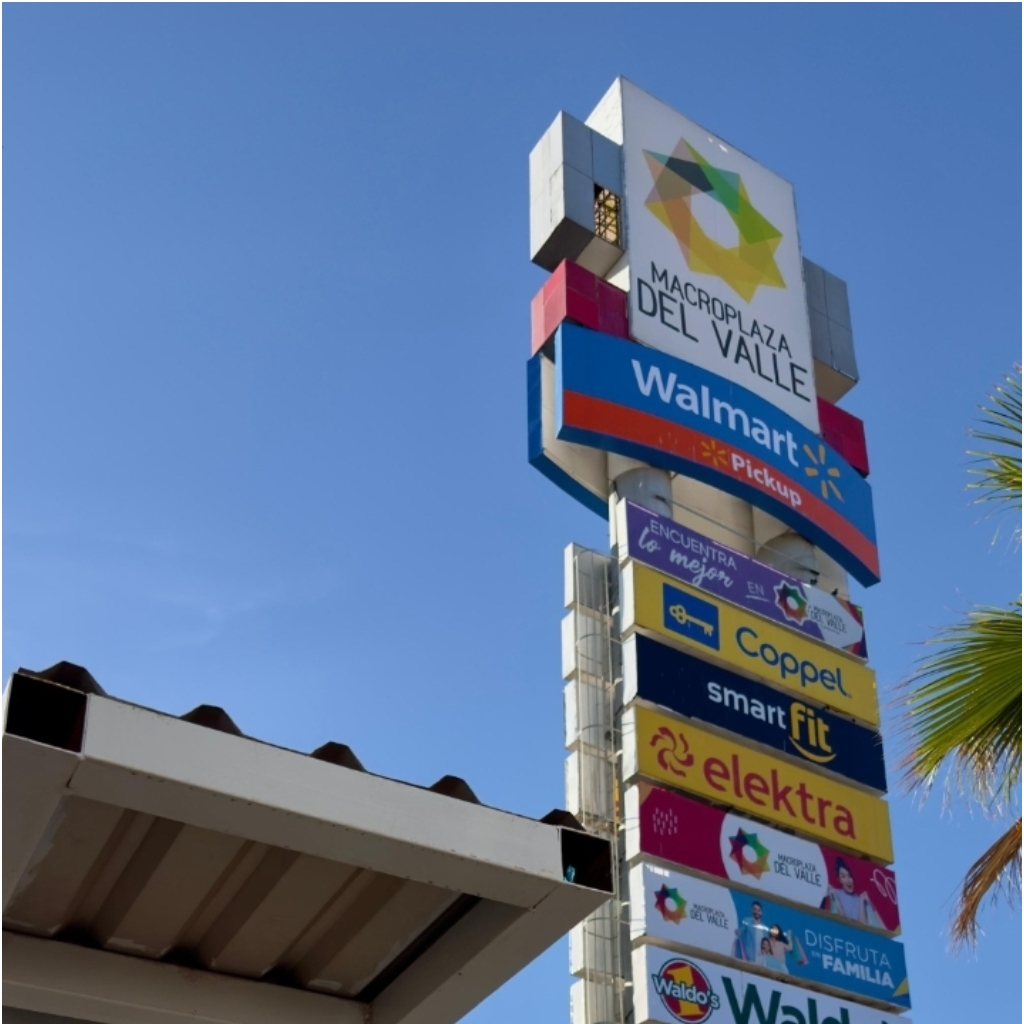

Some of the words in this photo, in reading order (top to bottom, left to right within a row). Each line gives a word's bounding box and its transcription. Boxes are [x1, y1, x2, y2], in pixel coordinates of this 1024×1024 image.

[651, 261, 792, 358] MACROPLAZA
[637, 278, 699, 343] DEL
[711, 320, 811, 402] VALLE
[632, 358, 799, 467] Walmart
[731, 454, 802, 507] Pickup
[638, 526, 661, 553] lo
[669, 549, 734, 588] mejor
[650, 519, 737, 571] ENCUENTRA
[747, 579, 765, 596] EN
[736, 626, 849, 697] Coppel
[707, 681, 786, 730] smart
[790, 701, 832, 753] fit
[703, 754, 857, 840] elektra
[774, 861, 791, 877] DEL
[794, 866, 822, 887] VALLE
[777, 853, 817, 873] MACROPLAZA
[690, 909, 706, 921] DEL
[709, 913, 729, 930] VALLE
[805, 929, 892, 969] DISFRUTA
[822, 954, 895, 989] FAMILIA
[652, 973, 720, 1011] Waldo's
